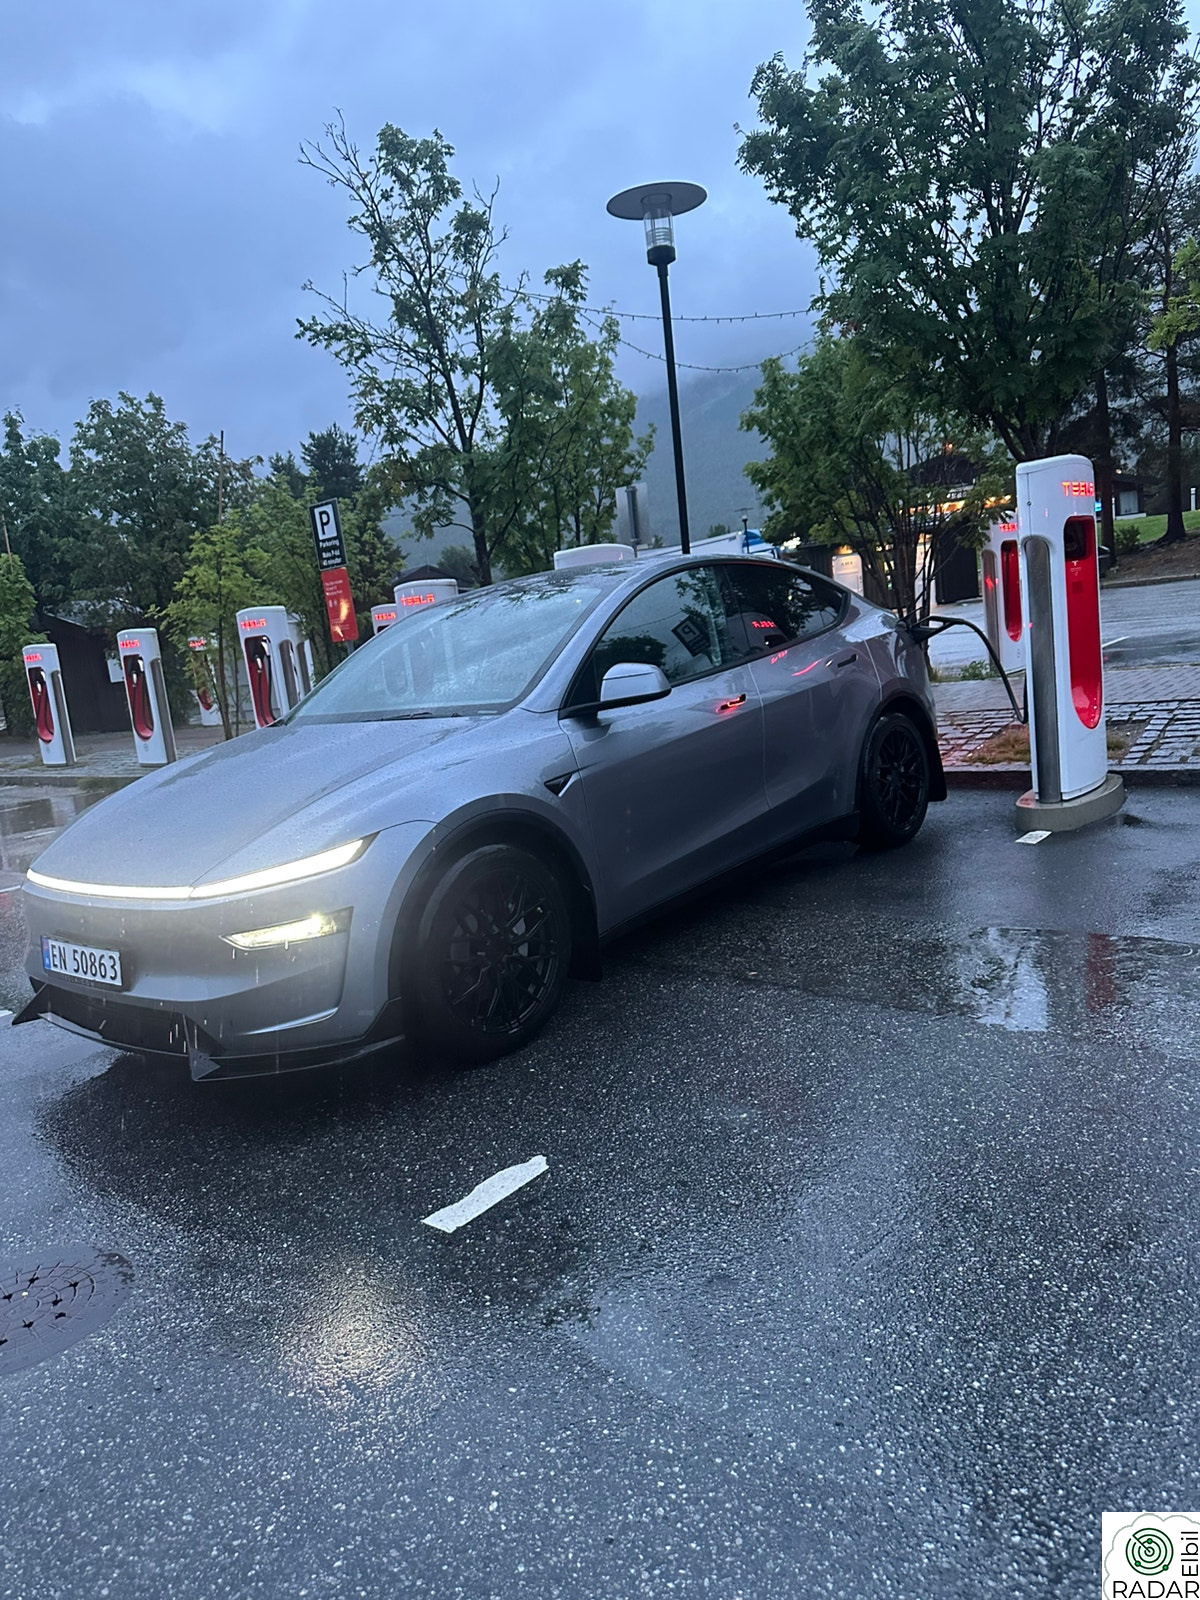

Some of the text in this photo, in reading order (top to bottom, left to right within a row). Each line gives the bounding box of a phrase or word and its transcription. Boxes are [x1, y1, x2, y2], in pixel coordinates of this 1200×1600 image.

[319, 510, 330, 535] P
[401, 594, 435, 606] TESLA
[374, 612, 396, 621] TESLA
[241, 619, 266, 629] TESLA
[51, 944, 118, 980] EN 50863
